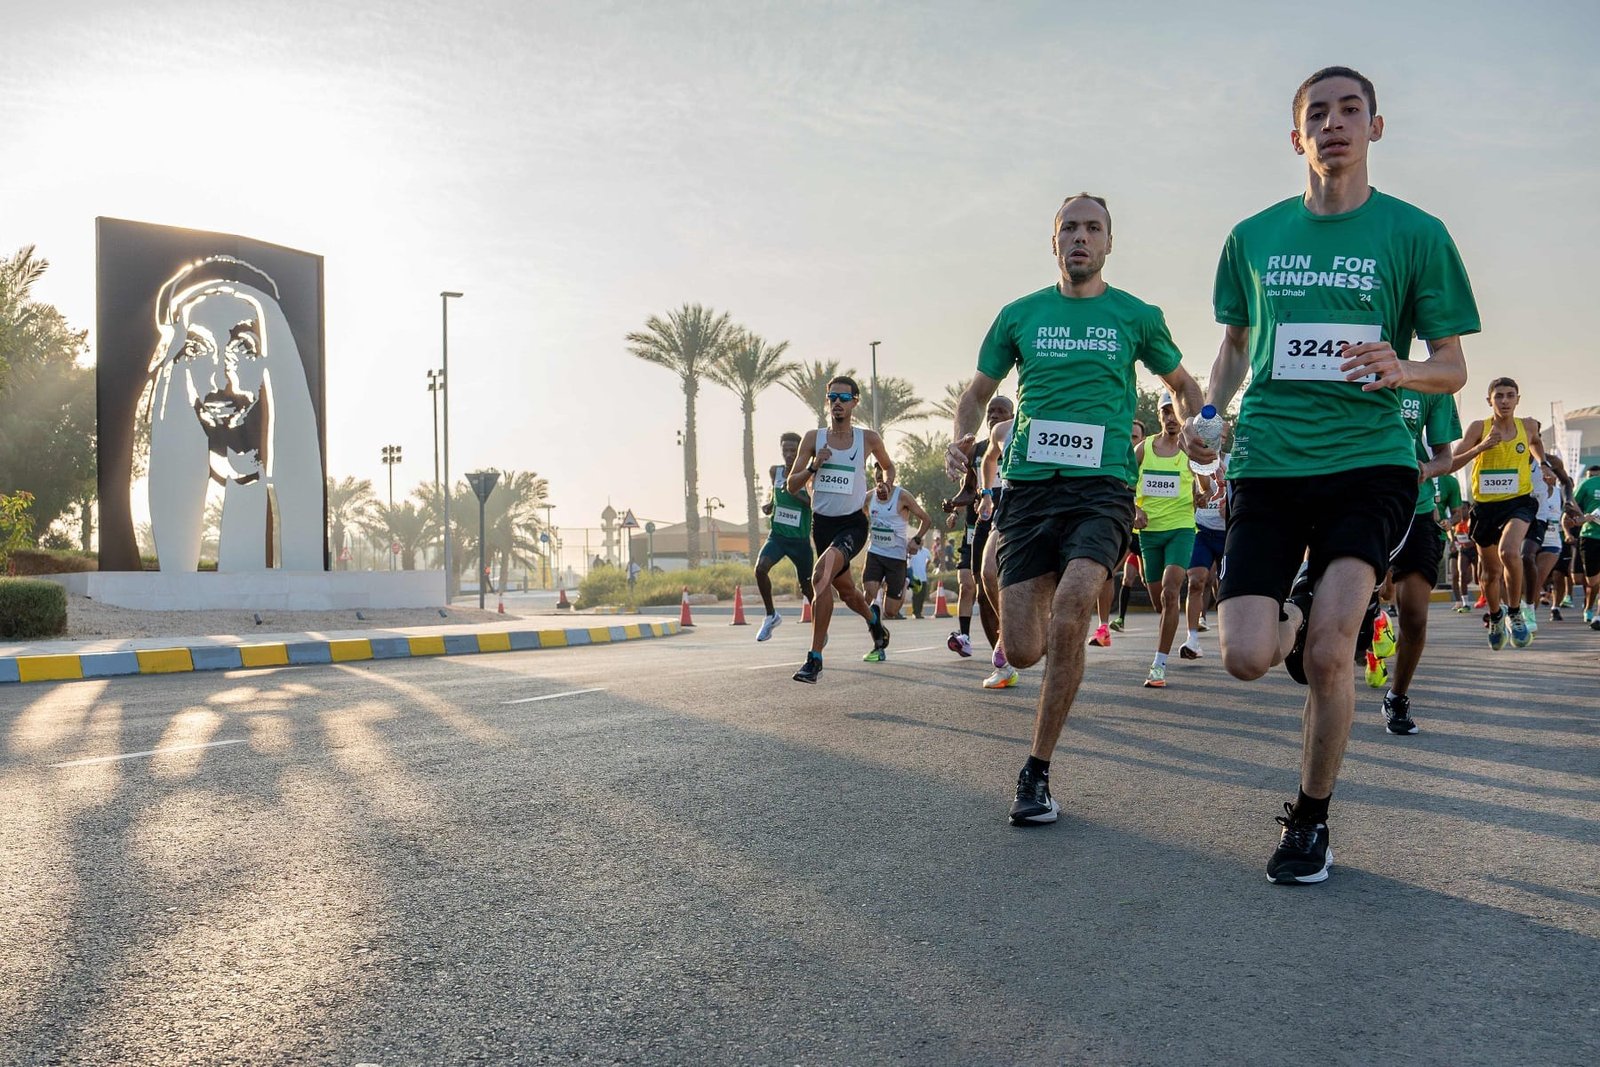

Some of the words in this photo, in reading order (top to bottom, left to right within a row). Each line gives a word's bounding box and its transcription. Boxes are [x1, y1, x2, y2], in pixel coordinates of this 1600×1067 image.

[1267, 255, 1312, 270] RUN
[1332, 255, 1377, 274] FOR
[1265, 271, 1375, 291] KINDNESS
[1281, 288, 1306, 297] Dhabi
[1037, 326, 1070, 338] RUN
[1086, 326, 1117, 340] FOR
[1036, 338, 1117, 352] KINDNESS
[1287, 339, 1363, 358] 3242
[1037, 432, 1093, 450] 32093
[820, 474, 849, 485] 32460
[1146, 480, 1175, 489] 32884
